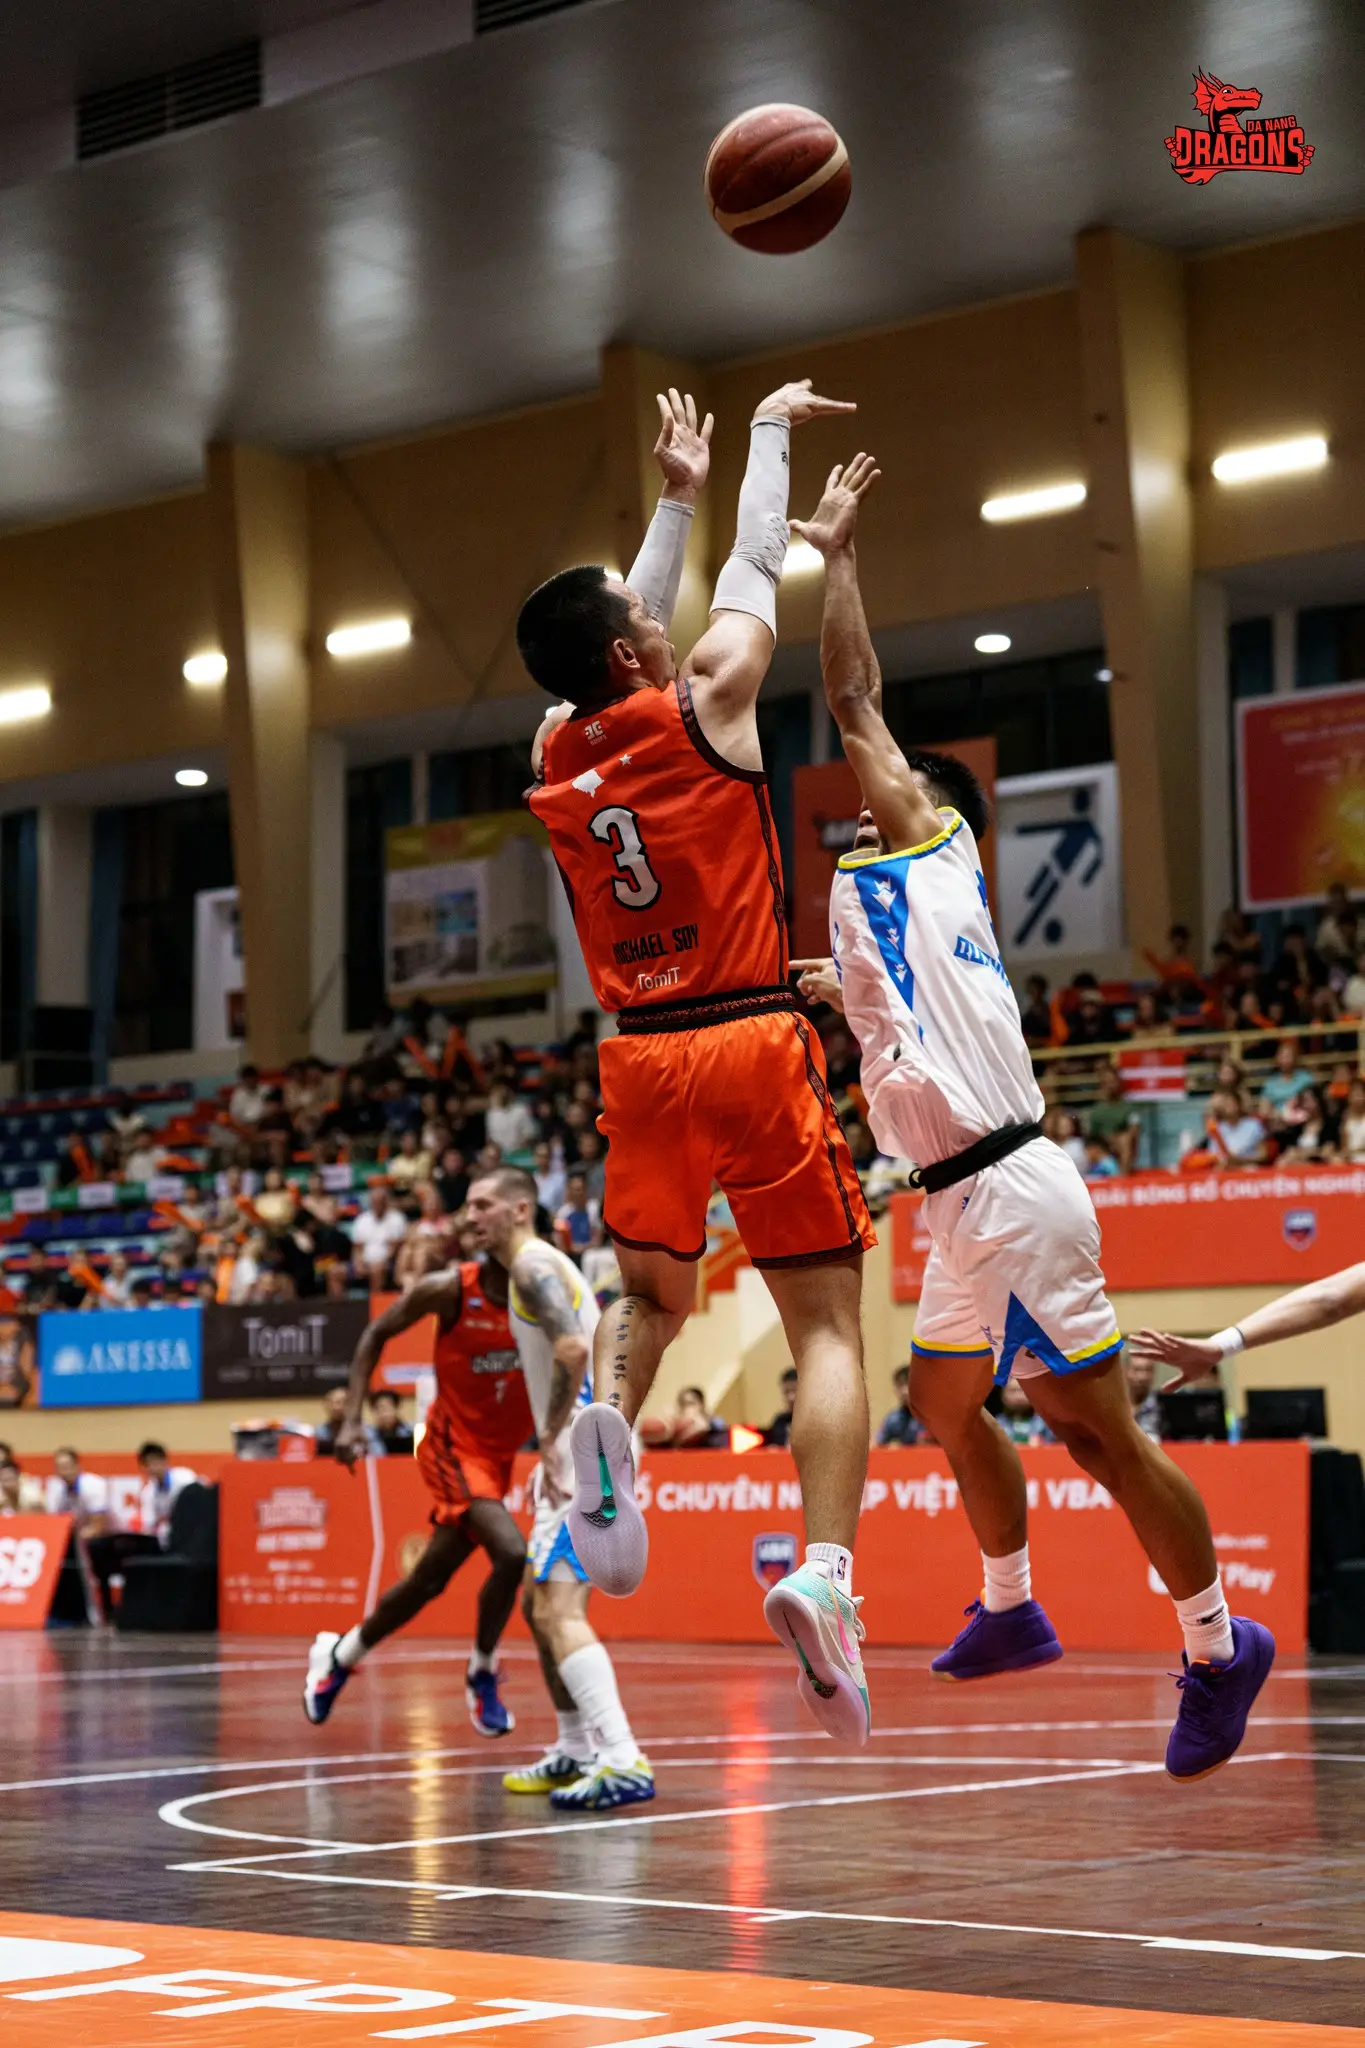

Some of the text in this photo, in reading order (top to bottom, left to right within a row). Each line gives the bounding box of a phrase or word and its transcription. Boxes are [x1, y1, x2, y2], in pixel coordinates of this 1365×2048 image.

[587, 804, 662, 911] 3
[612, 924, 699, 965] MICHAEL SOY
[638, 966, 680, 991] TomiT
[87, 1338, 191, 1374] ANESSA
[243, 1314, 328, 1360] TomiT
[655, 1472, 774, 1512] CHUYÊN
[892, 1471, 959, 1518] VIỆT
[1044, 1478, 1113, 1510] VBA
[3, 1969, 670, 2040] FPT
